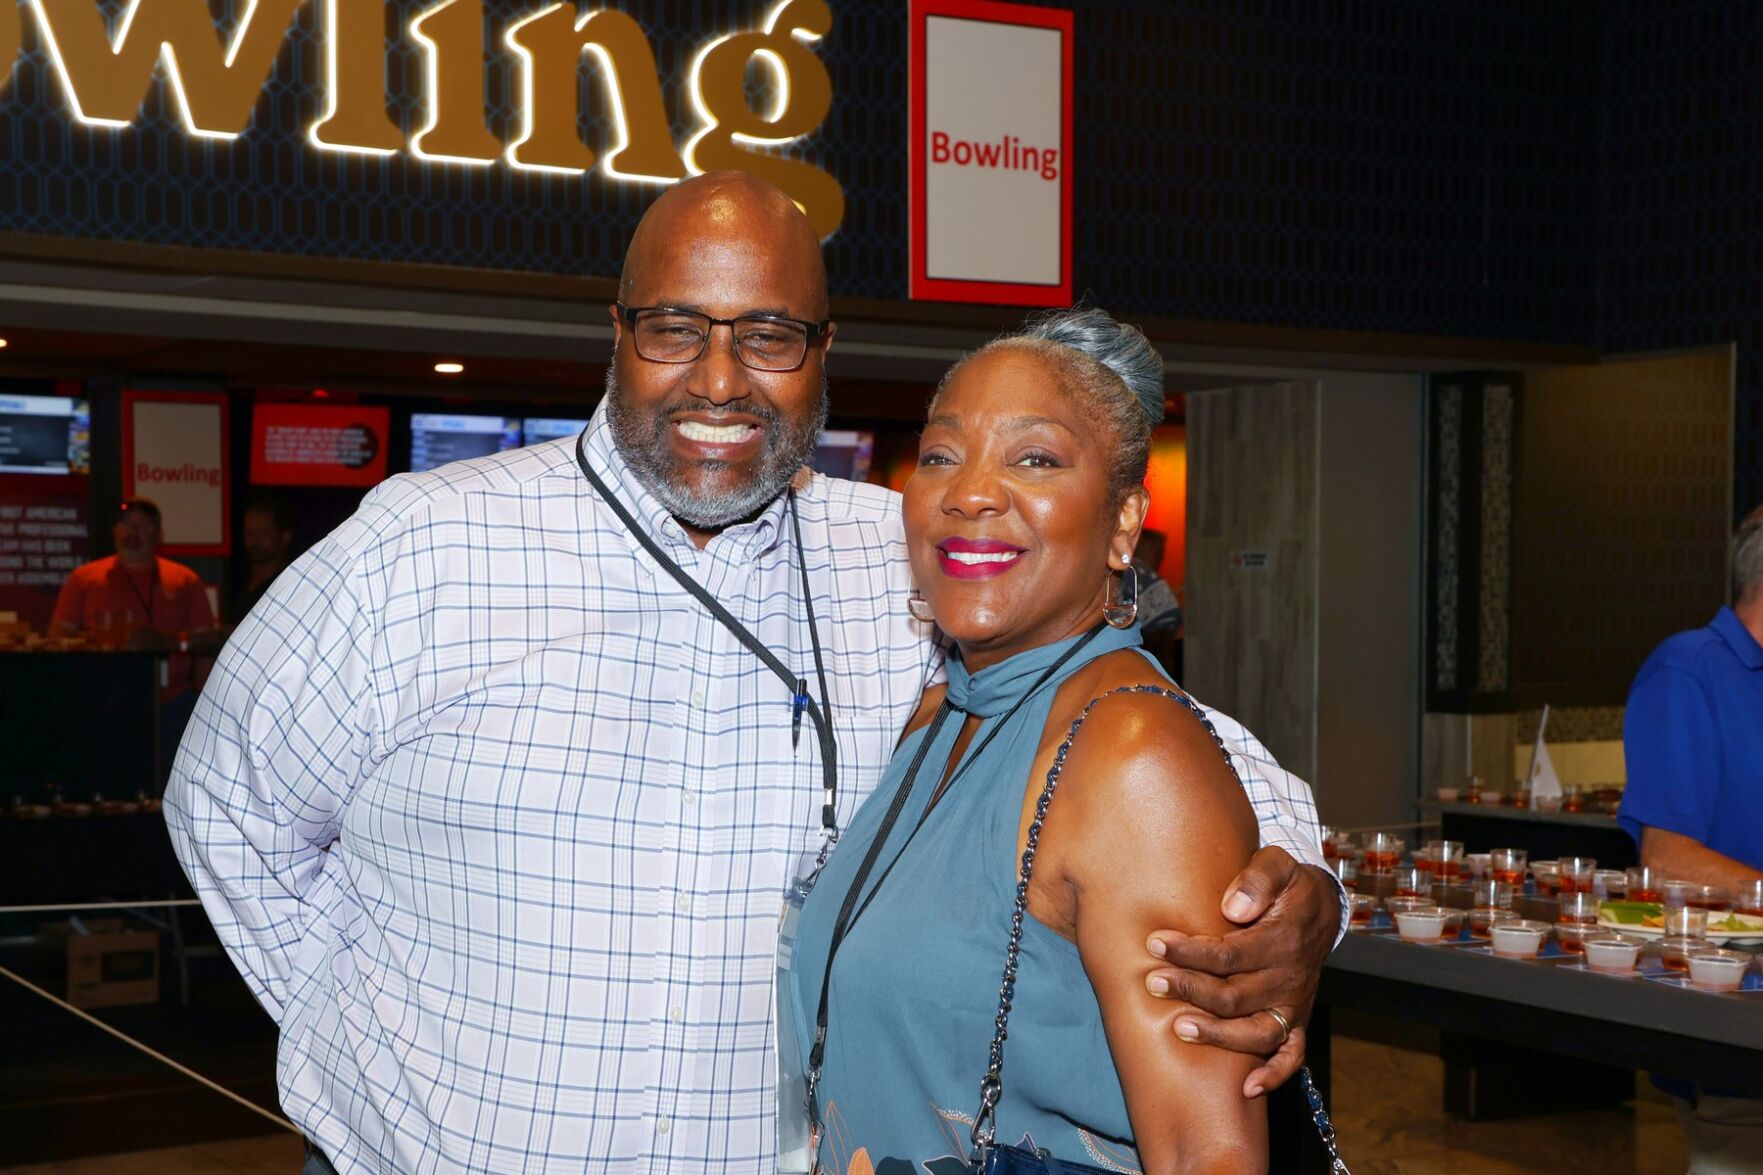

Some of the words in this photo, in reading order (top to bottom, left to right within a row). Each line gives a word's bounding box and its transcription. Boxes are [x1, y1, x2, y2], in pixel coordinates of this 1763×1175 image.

[0, 0, 845, 242] wling
[931, 131, 1058, 181] Bowling
[137, 462, 220, 488] Bowling
